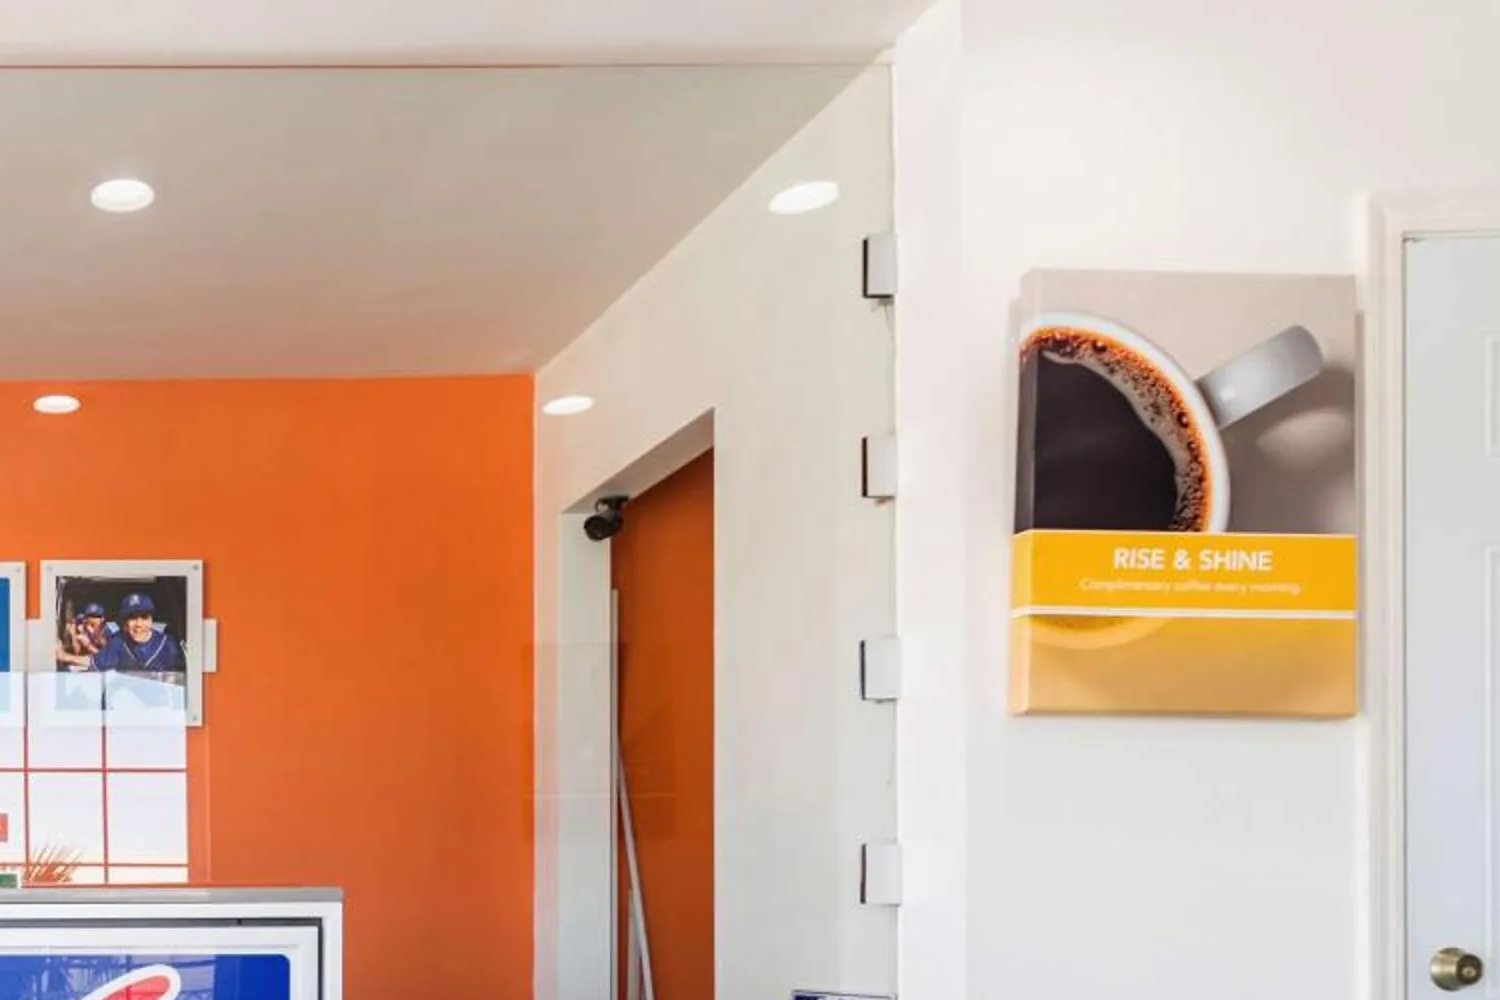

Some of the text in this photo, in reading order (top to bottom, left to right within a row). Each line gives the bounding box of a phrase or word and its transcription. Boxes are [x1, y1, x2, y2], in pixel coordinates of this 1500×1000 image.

[1113, 547, 1273, 572] RISE & SHINE
